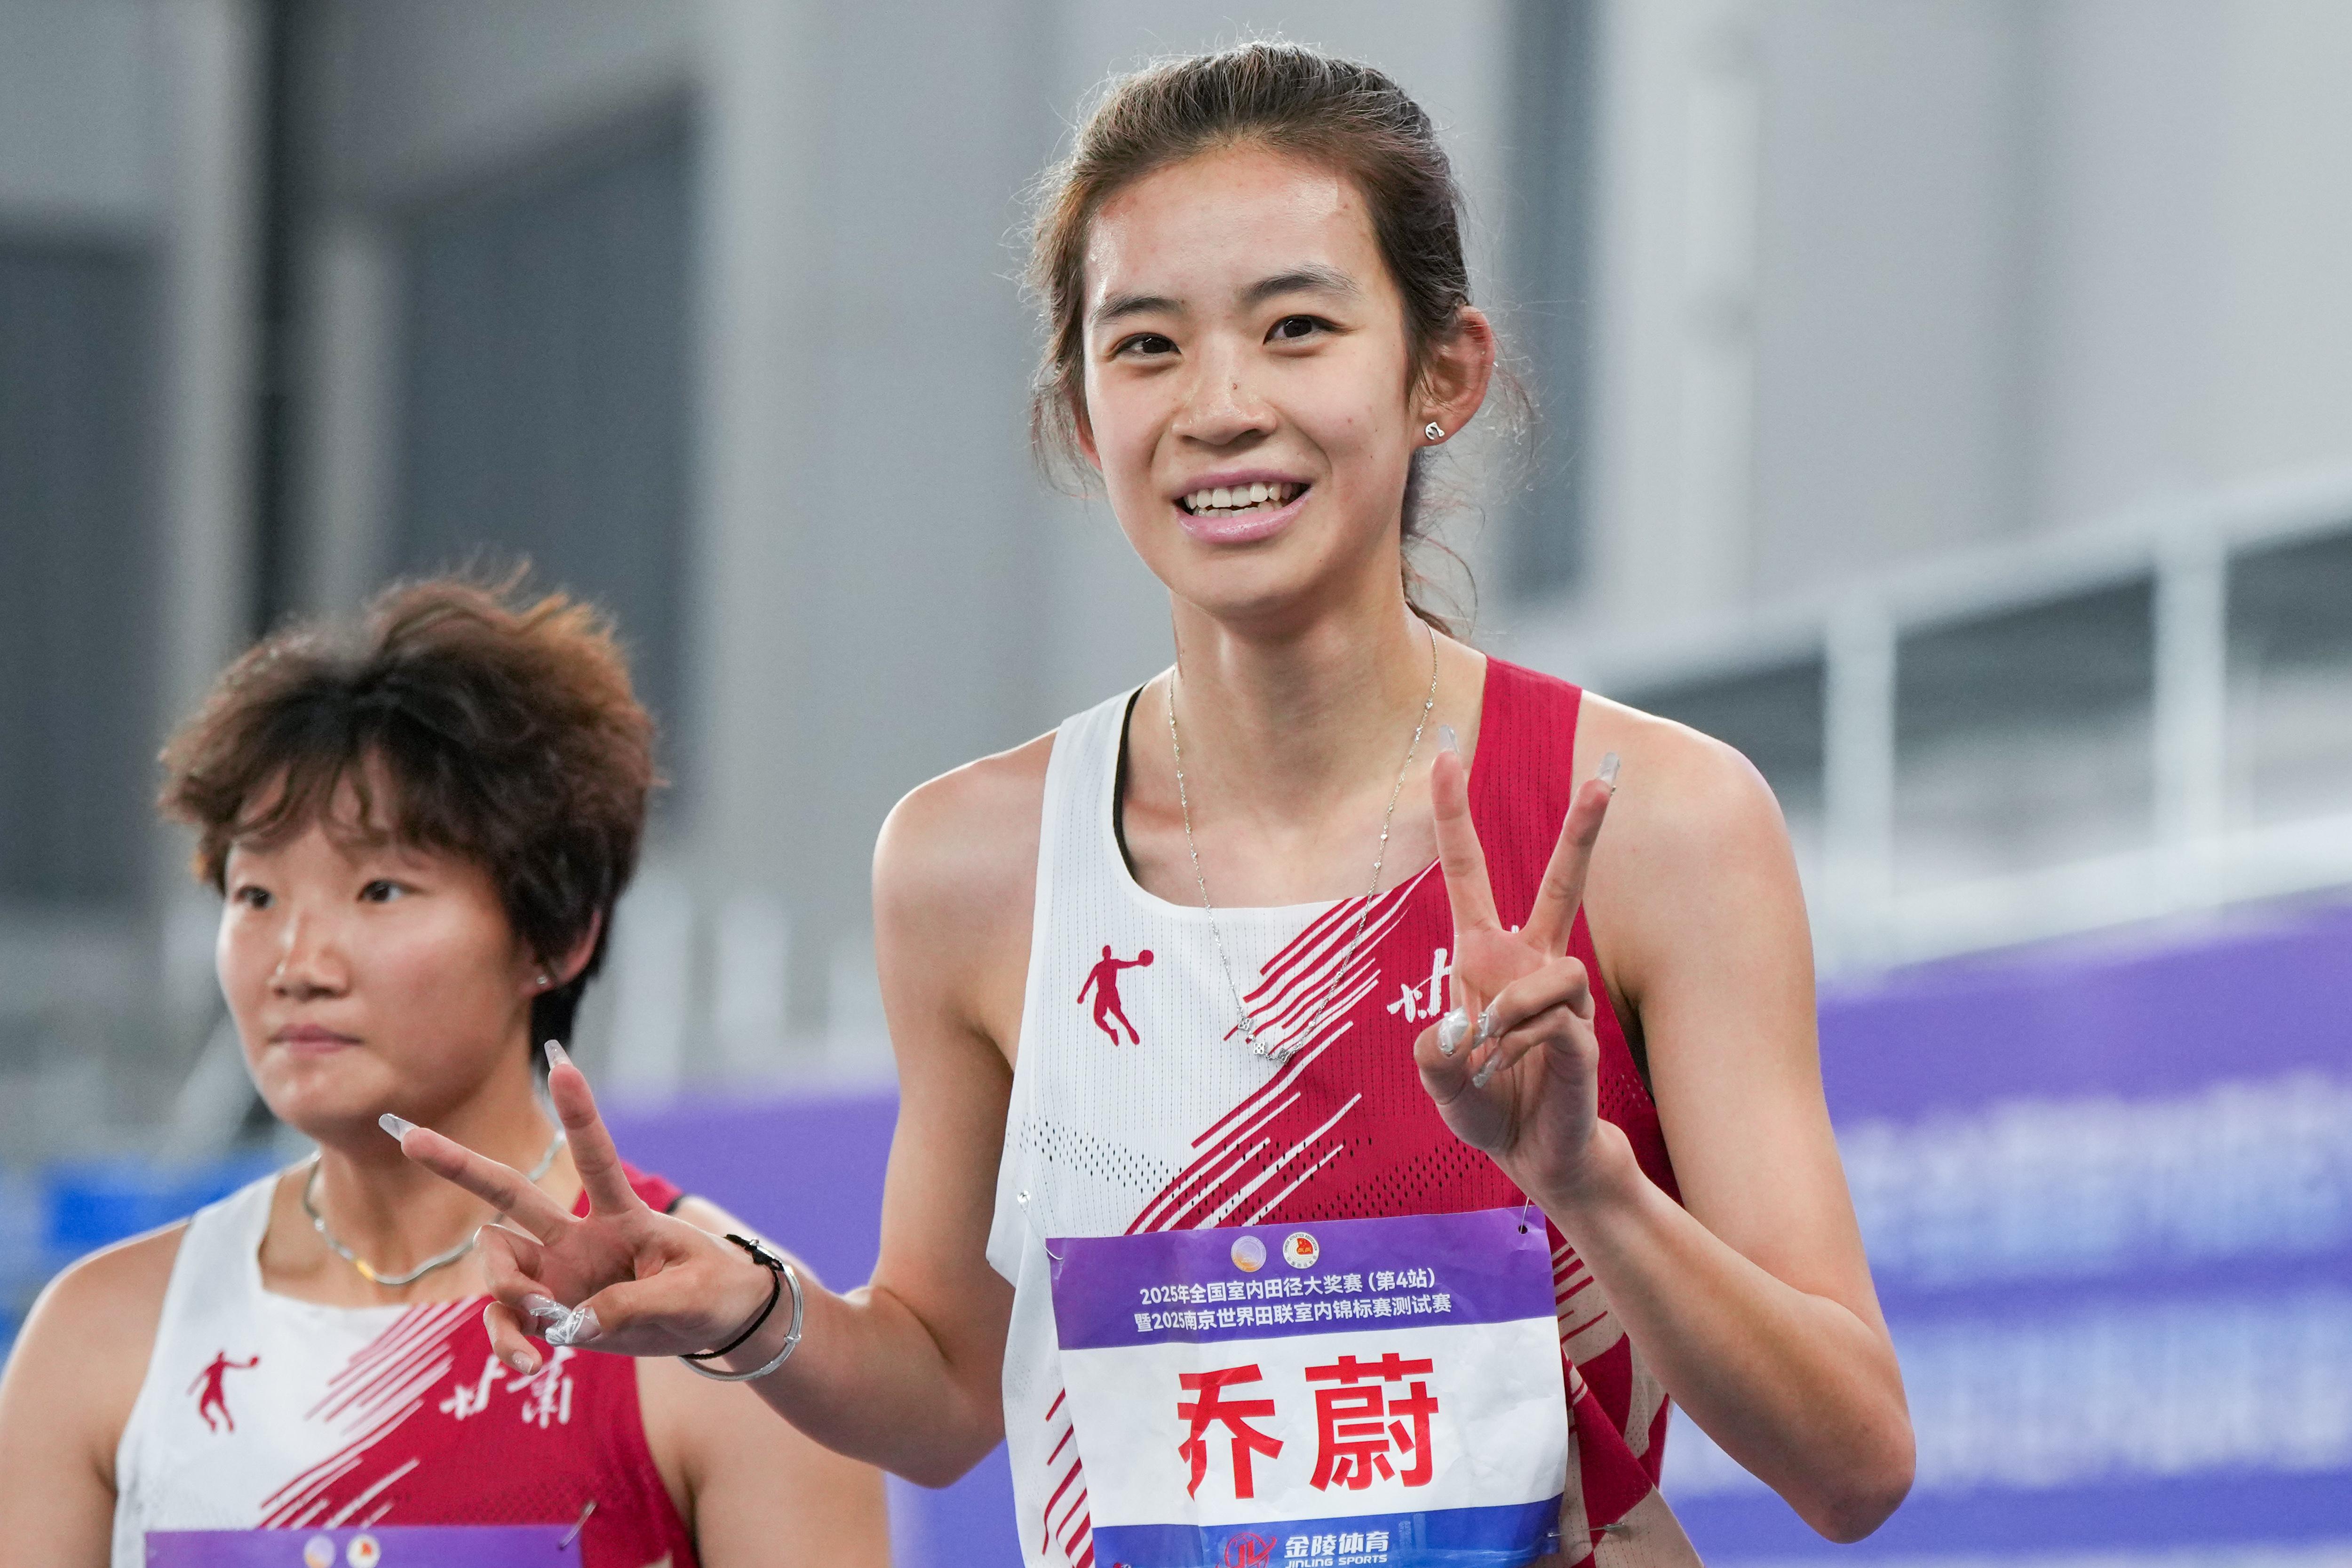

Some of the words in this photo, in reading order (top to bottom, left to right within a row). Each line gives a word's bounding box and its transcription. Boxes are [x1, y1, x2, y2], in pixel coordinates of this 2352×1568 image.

[1134, 1293, 1452, 1332] 暨2025南京世界田联室内锦标赛测试赛
[1177, 1353, 1438, 1501] 乔蔚
[1284, 1531, 1390, 1558] 金陵体育
[1285, 1558, 1333, 1568] JINLING
[1339, 1554, 1388, 1565] SPORTS
